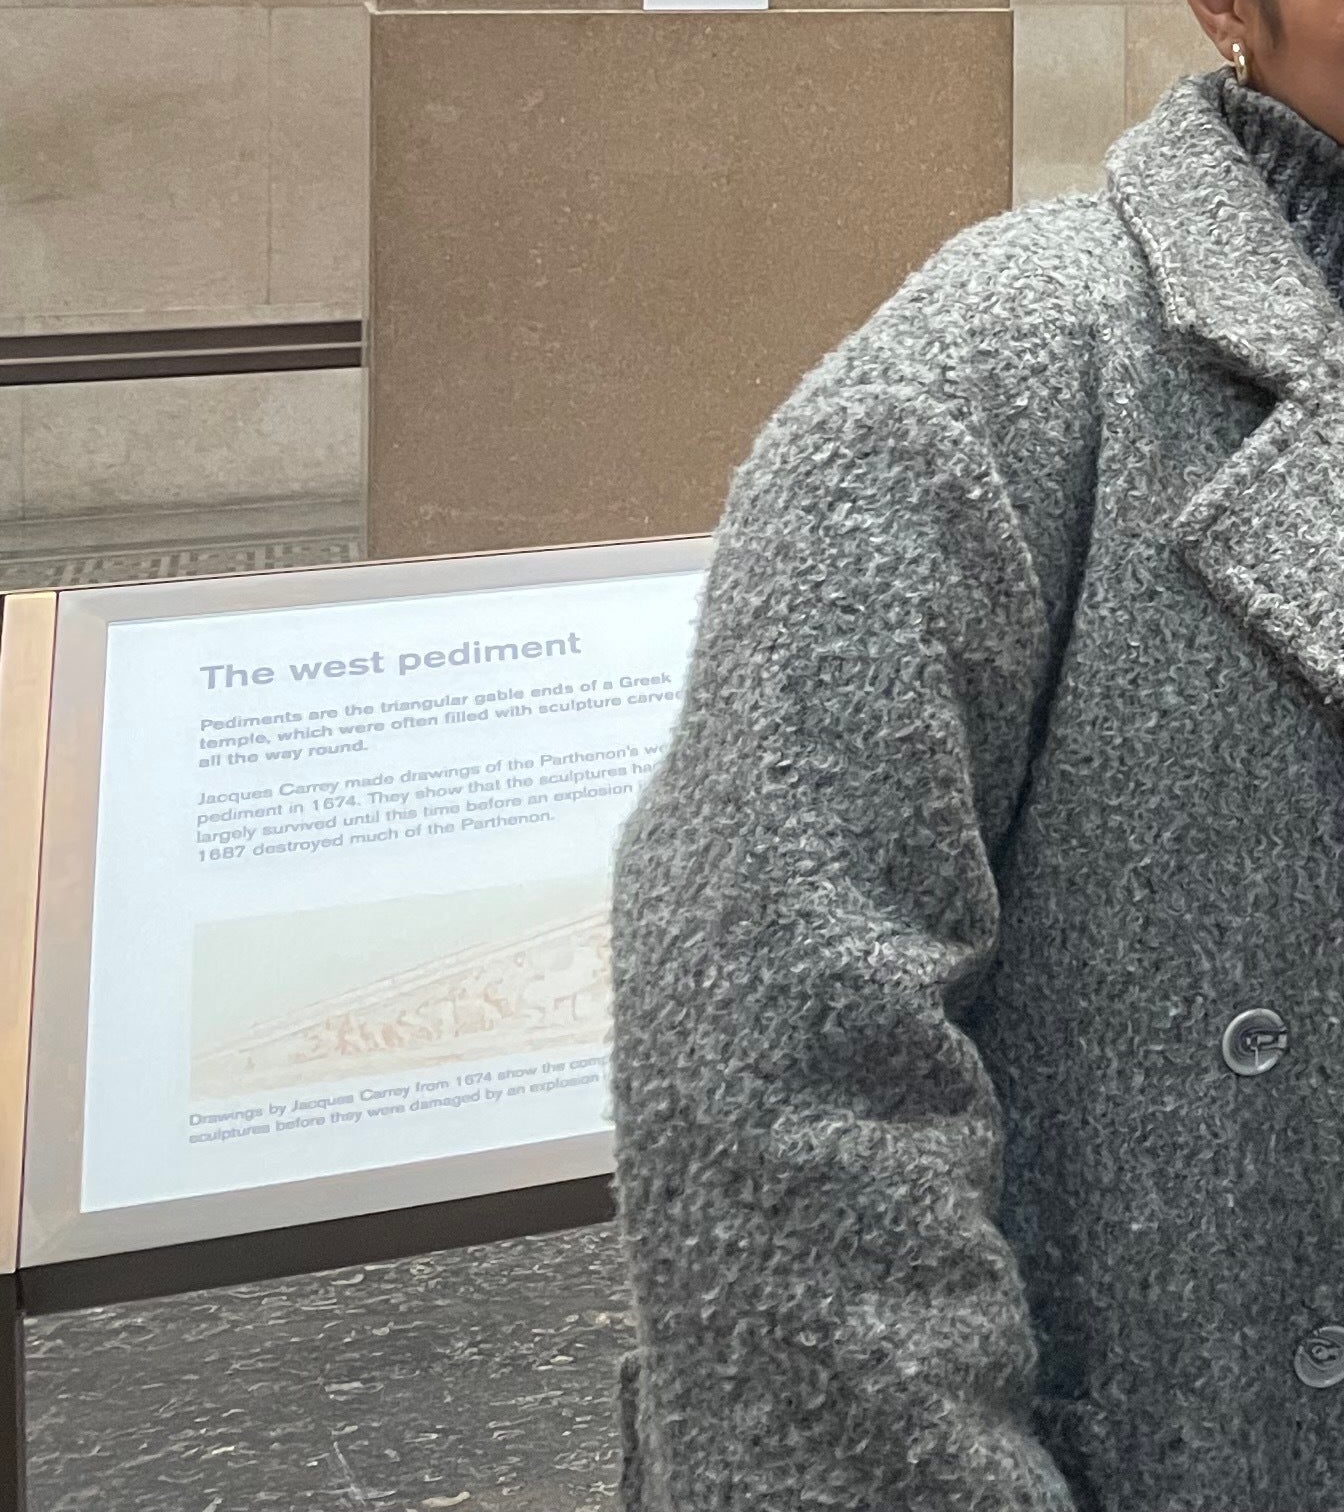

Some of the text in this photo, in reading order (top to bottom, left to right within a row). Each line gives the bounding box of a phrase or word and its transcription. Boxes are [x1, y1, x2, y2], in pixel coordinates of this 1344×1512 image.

[199, 631, 582, 690] The west pediment
[199, 731, 272, 750] temple,
[277, 724, 334, 742] which
[338, 722, 386, 735] were
[390, 716, 439, 730] often
[444, 708, 489, 725] filled
[494, 704, 533, 719] with
[538, 697, 622, 715] sculpture
[200, 671, 673, 732] Pediments are the triangular gable ends of a Greek
[197, 738, 369, 769] all the way round.
[197, 788, 274, 806] Jacques
[278, 780, 340, 797] Carrey
[344, 772, 395, 789] made
[398, 765, 482, 784] drawings
[485, 759, 504, 774] of
[506, 757, 535, 772] the
[540, 744, 640, 768] Parthenon's
[196, 803, 283, 828] pediment
[288, 801, 305, 815] in
[312, 794, 363, 812] 1674.
[366, 791, 411, 806] They
[414, 785, 463, 801] show
[467, 779, 502, 795] that
[506, 775, 534, 790] the
[539, 766, 628, 786] sculptures
[196, 825, 258, 845] largely
[262, 815, 337, 836] survived
[343, 809, 380, 827] until
[385, 806, 418, 822] this
[423, 804, 461, 818] time
[465, 796, 524, 812] before
[527, 793, 549, 806] an
[553, 783, 633, 803] explosion
[198, 811, 556, 863] 1687 destroyed much of the Parthenon.
[188, 1124, 271, 1144] sculptures
[275, 1116, 326, 1132] before
[329, 1110, 363, 1124] they
[366, 1104, 406, 1118] were
[409, 1088, 481, 1112] damaged
[484, 1087, 504, 1103] by
[506, 1085, 526, 1097] an
[529, 1073, 600, 1094] explosion
[189, 1107, 264, 1127] Drawings
[268, 1102, 287, 1117] by
[290, 1094, 355, 1113] Jacques
[359, 1085, 411, 1102] Carrey
[415, 1079, 450, 1093] from
[456, 1071, 493, 1087] 1674
[497, 1067, 538, 1081] show
[541, 1061, 566, 1074] the
